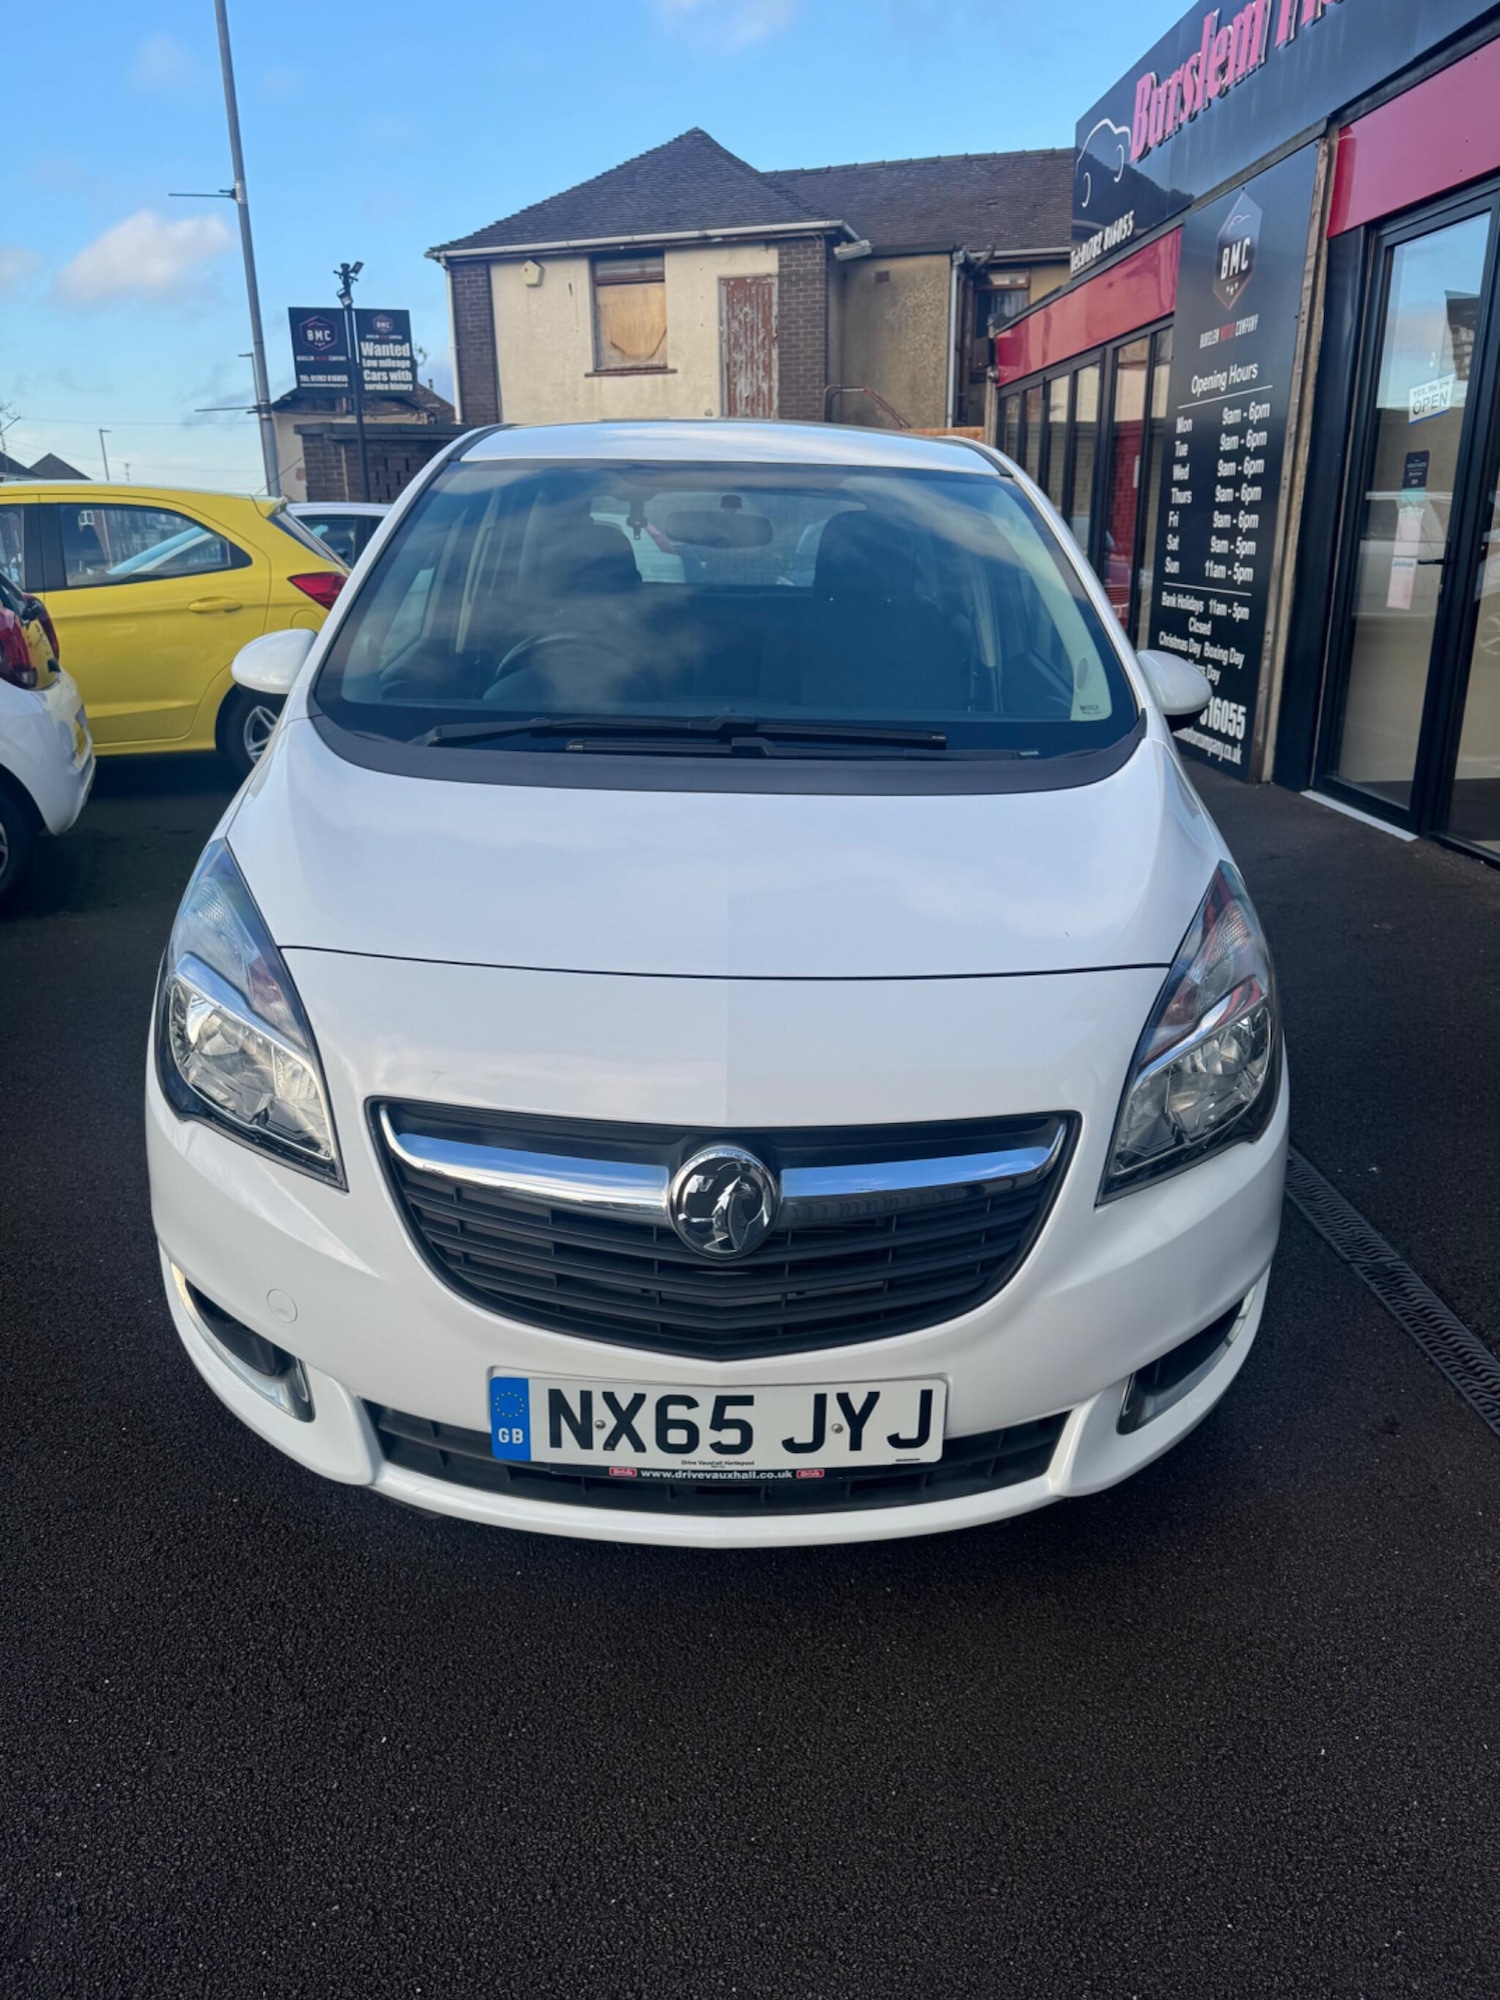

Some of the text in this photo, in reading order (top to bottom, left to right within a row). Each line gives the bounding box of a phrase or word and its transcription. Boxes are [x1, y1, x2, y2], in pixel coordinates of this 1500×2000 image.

[1130, 0, 1268, 164] Burslem
[1220, 237, 1250, 280] BMC
[307, 330, 331, 341] BMC
[360, 341, 411, 357] Wanted
[362, 358, 411, 369] Low mileage
[363, 369, 413, 381] Cars with
[364, 382, 413, 391] service history
[1191, 363, 1259, 397] Opening Hours
[1412, 390, 1449, 415] OPEN
[1176, 416, 1192, 434] Mon
[1222, 407, 1241, 425] 9am
[1249, 401, 1270, 425] 6pm
[1174, 440, 1188, 457] Tue
[1220, 433, 1239, 451] 9am
[1246, 429, 1267, 452] 6pm
[1173, 463, 1190, 480] Wed
[1217, 459, 1236, 477] 9am
[1243, 456, 1265, 479] 6pm
[1171, 487, 1192, 504] Thurs
[1215, 484, 1234, 502] 9am
[1241, 483, 1262, 506] 6pm
[1168, 511, 1179, 527] Fri
[1213, 510, 1231, 528] 9am
[1238, 510, 1259, 533] 6pm
[1166, 534, 1179, 550] Sat
[1210, 535, 1229, 553] 9am
[1235, 536, 1256, 559] 5pm
[1165, 556, 1180, 574] Sun
[1205, 559, 1227, 578] 11am
[1233, 562, 1254, 585] 5pm
[1161, 591, 1177, 607] Bank
[1177, 594, 1204, 615] Holidays
[1209, 598, 1227, 616] 11am
[1232, 601, 1250, 622] 5pm
[1188, 617, 1212, 636] Closed
[1159, 631, 1188, 652] Christmas
[1188, 638, 1202, 658] Day
[1203, 641, 1229, 666] Boxing
[1229, 647, 1245, 669] Day
[1207, 664, 1221, 685] Day
[548, 1388, 933, 1455] NX65 JYJ
[498, 1427, 524, 1444] GB
[640, 1469, 793, 1479] www.drivevauxhall.co.uk
